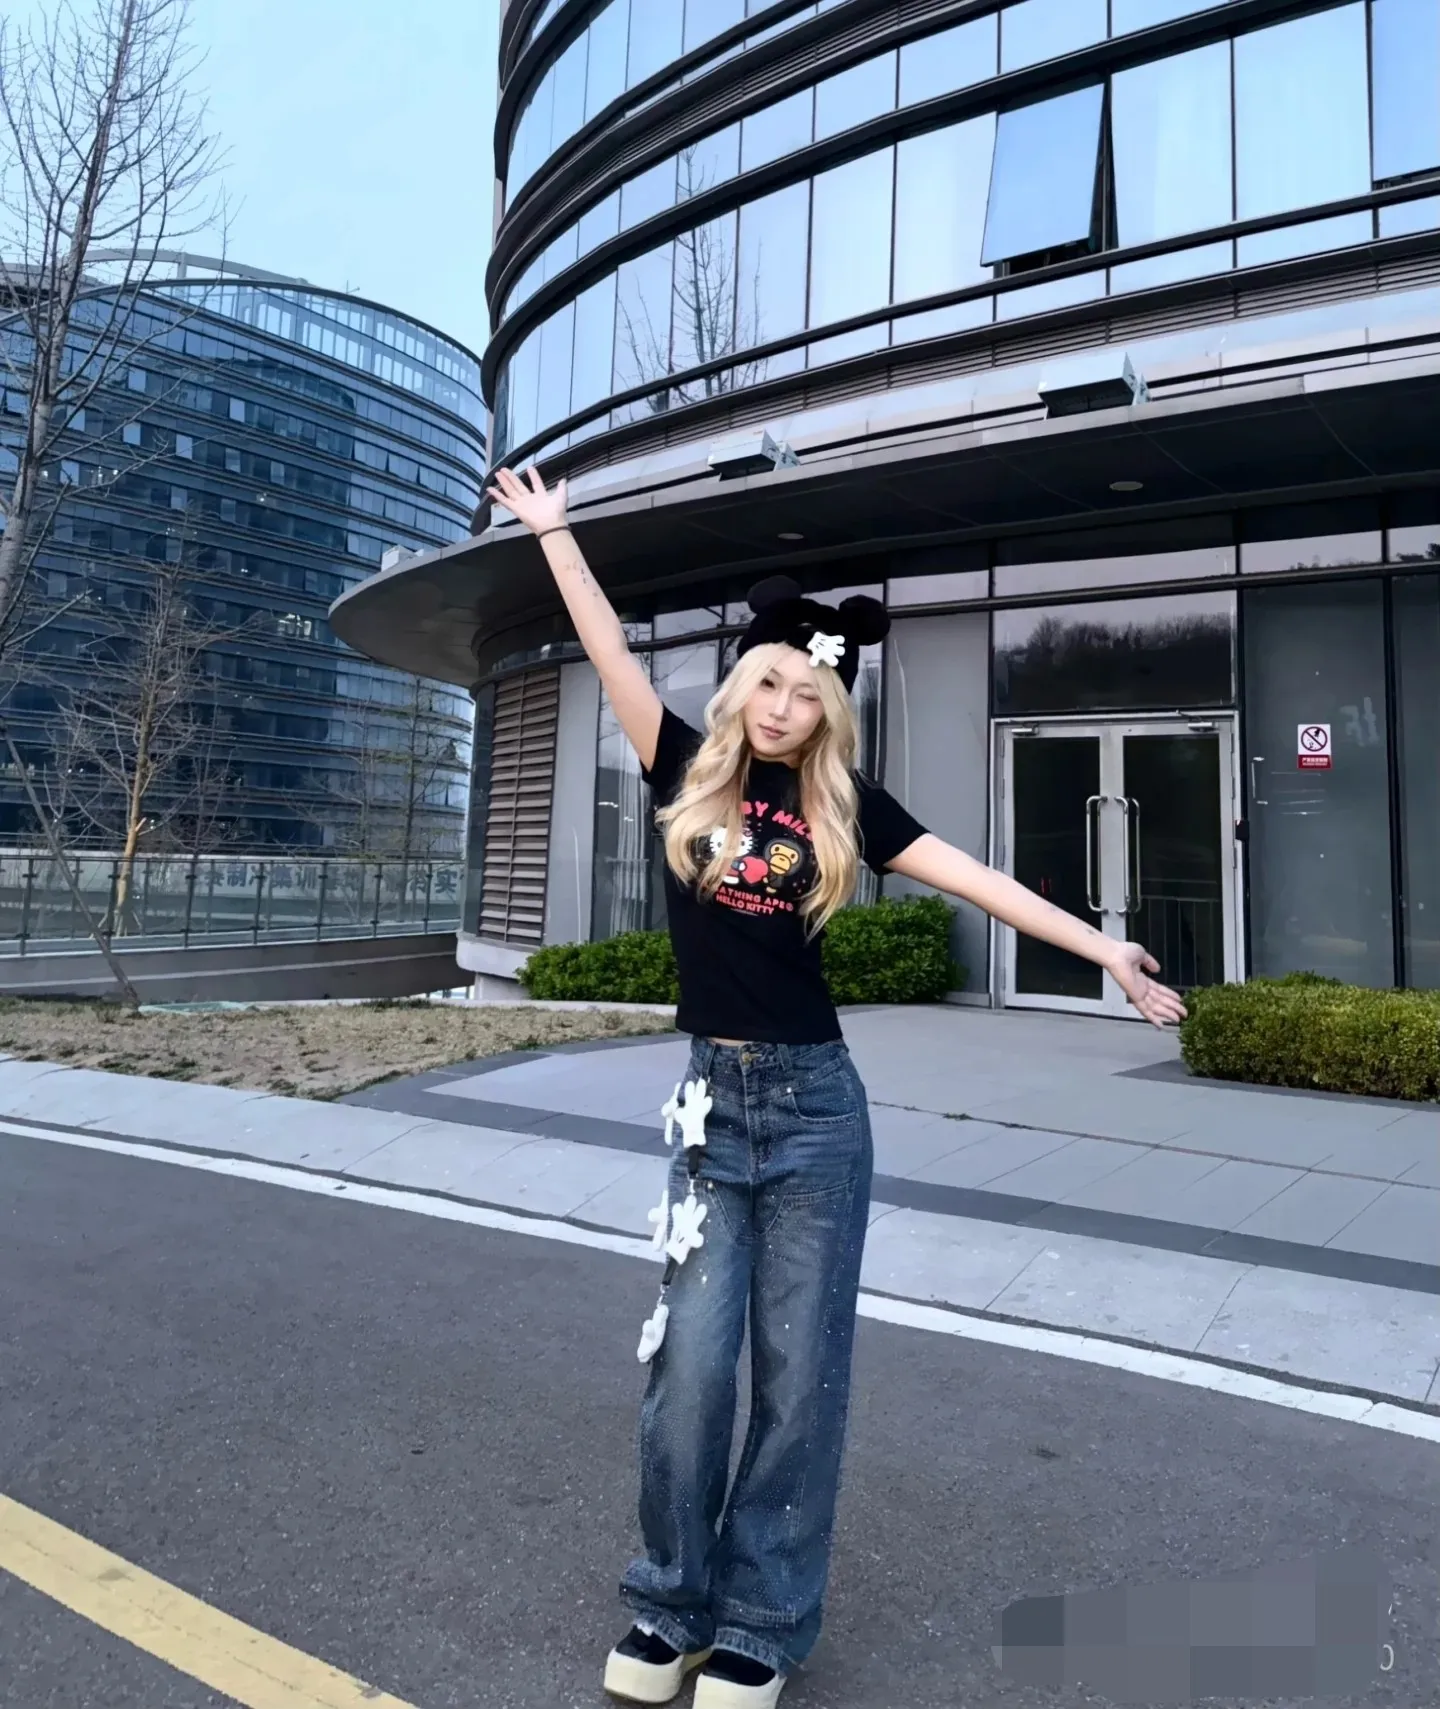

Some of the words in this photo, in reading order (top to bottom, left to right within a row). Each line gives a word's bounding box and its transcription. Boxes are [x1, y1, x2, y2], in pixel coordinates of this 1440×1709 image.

[740, 801, 769, 817] BY
[720, 886, 761, 903] ATHING
[716, 894, 745, 909] HELLO
[746, 902, 775, 915] KITTY
